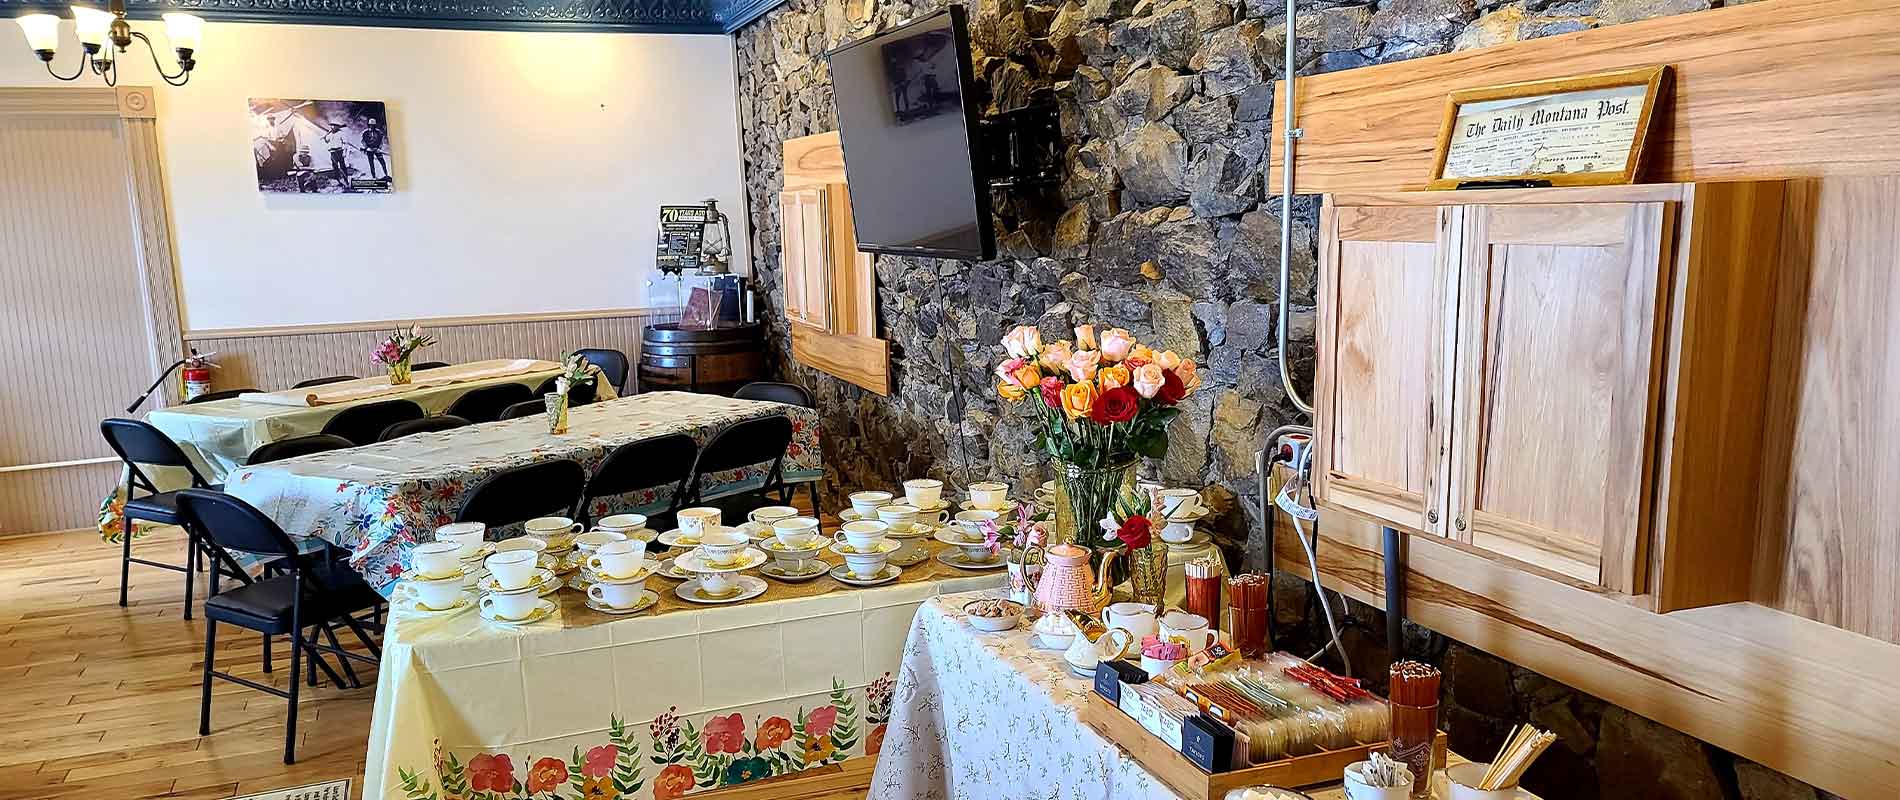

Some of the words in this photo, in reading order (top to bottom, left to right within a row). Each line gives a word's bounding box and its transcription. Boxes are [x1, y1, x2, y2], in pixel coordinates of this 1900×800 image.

[1466, 122, 1486, 138] The
[1492, 113, 1524, 133] Daily
[1529, 106, 1588, 127] Montana
[662, 209, 679, 223] 70
